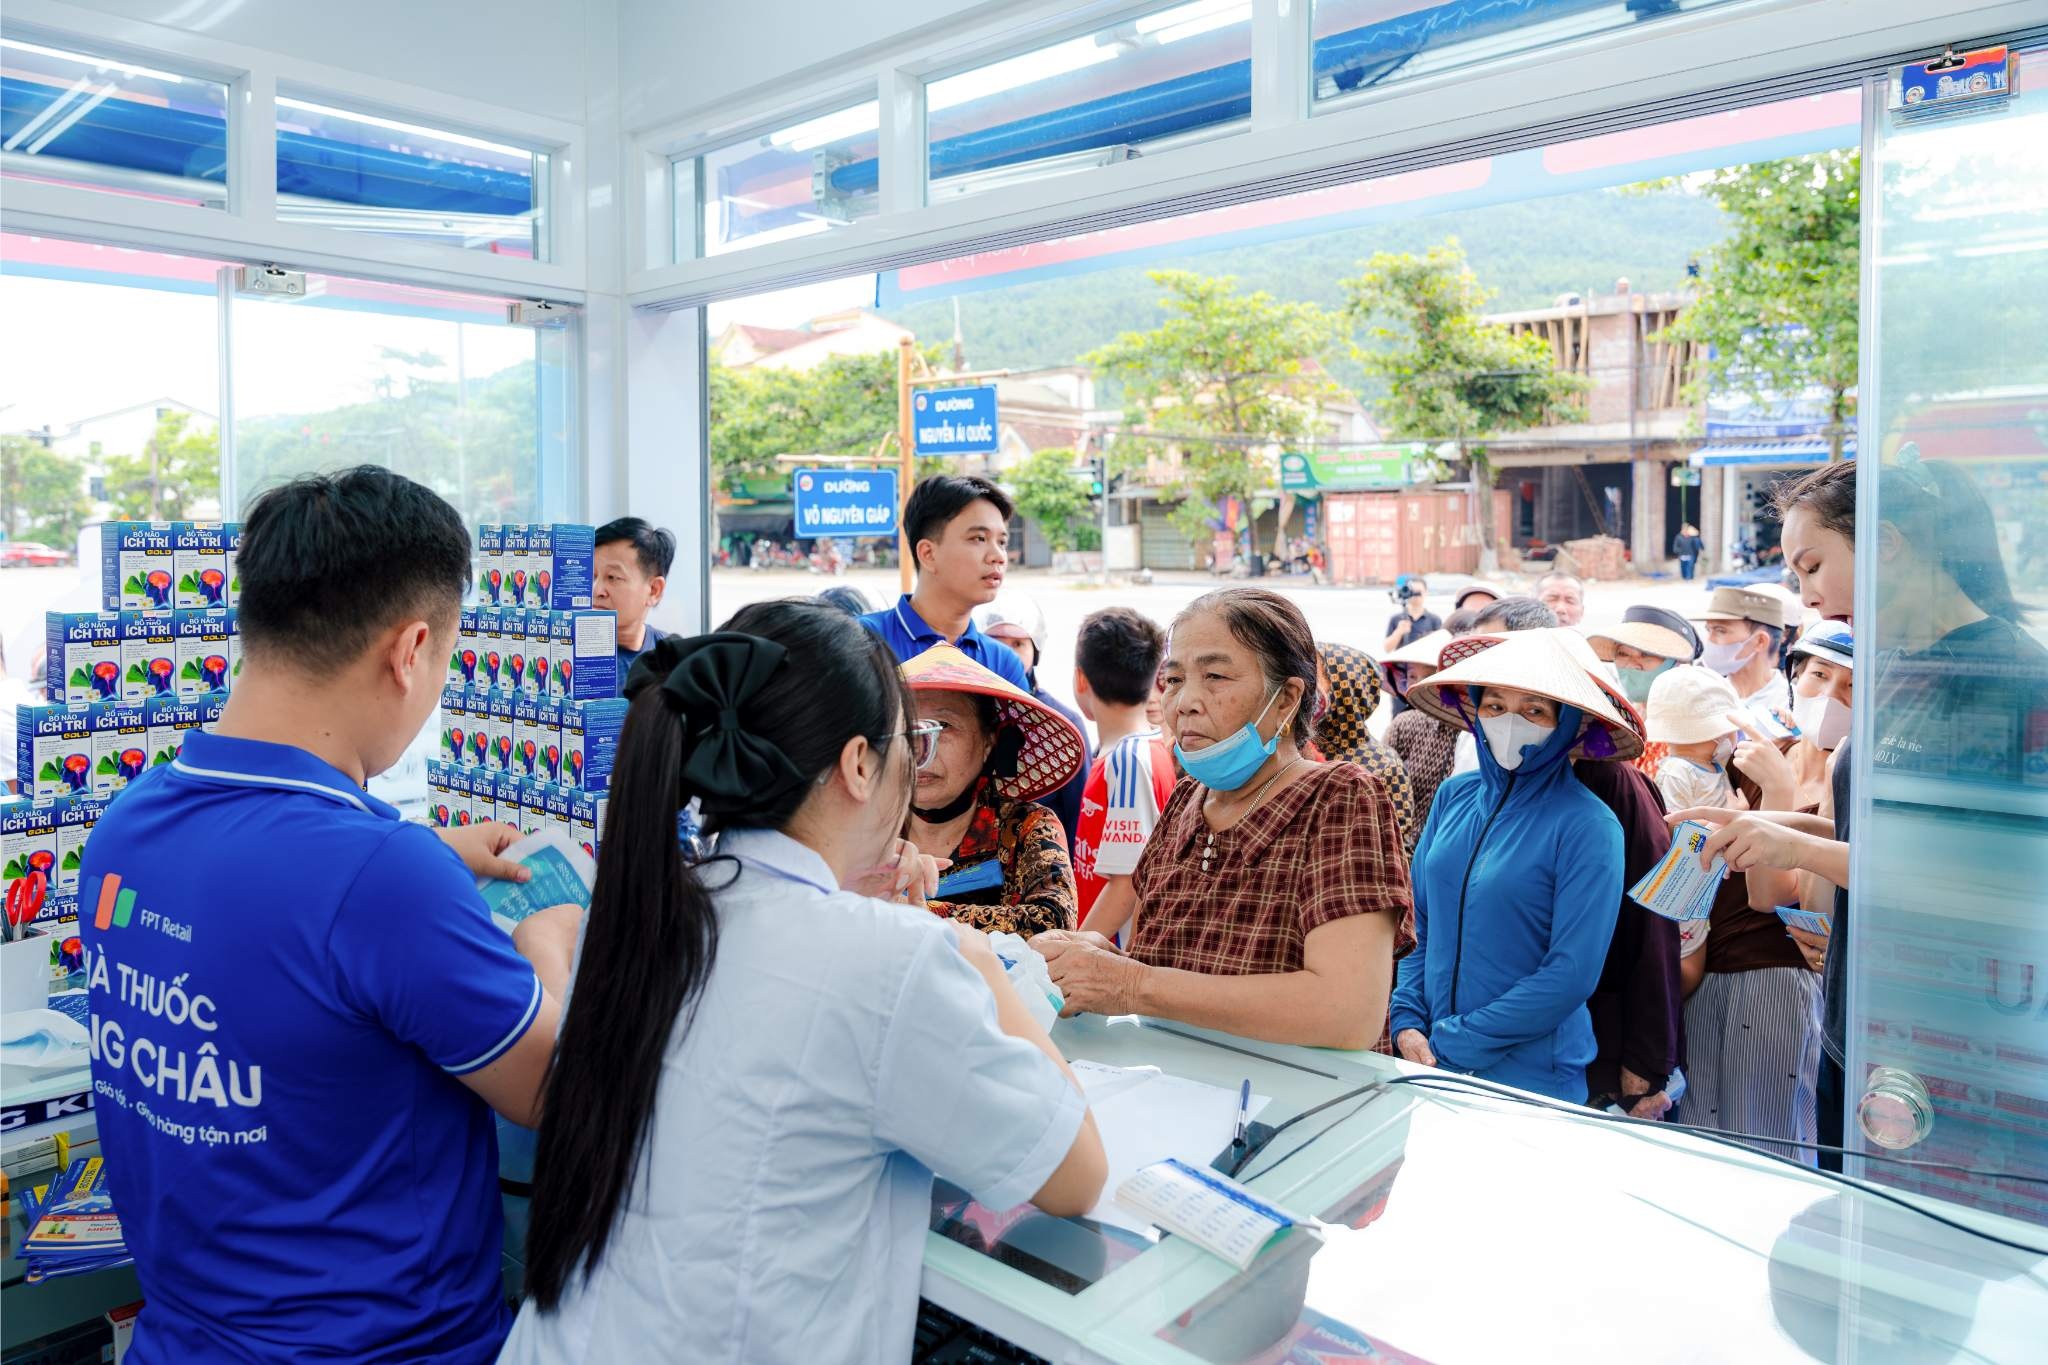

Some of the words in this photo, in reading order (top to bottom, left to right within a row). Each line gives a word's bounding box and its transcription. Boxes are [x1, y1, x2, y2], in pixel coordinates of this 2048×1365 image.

[123, 535, 146, 547] ÍCH
[148, 535, 169, 547] TRÍ
[177, 535, 199, 547] ÍCH
[200, 535, 220, 547] TRÍ
[230, 536, 241, 547] ÍC
[69, 627, 92, 640] ÍCH
[94, 626, 116, 638] TRÍ
[125, 624, 147, 636] ÍCH
[149, 623, 171, 635] TRÍ
[180, 623, 202, 634] ÍCH
[204, 621, 224, 633] TRÍ
[96, 716, 118, 728] ÍCH
[120, 713, 142, 726] TRÍ
[152, 712, 174, 723] ÍCH
[177, 709, 198, 721] TRÍ
[39, 720, 62, 733] ÍCH
[64, 717, 87, 730] TRÍ
[3, 818, 27, 831] ÍCH
[29, 813, 52, 827] TRÍ
[61, 810, 85, 823] ÍCH
[27, 827, 55, 835] GOLD
[1105, 820, 1140, 831] VISIT
[140, 909, 160, 931] FPT
[163, 916, 192, 943] Retail
[116, 962, 218, 1032] THUỐC
[131, 1038, 262, 1108] CHÂU
[157, 1115, 195, 1144] hàng
[199, 1126, 230, 1147] tận
[234, 1125, 267, 1144] nơi
